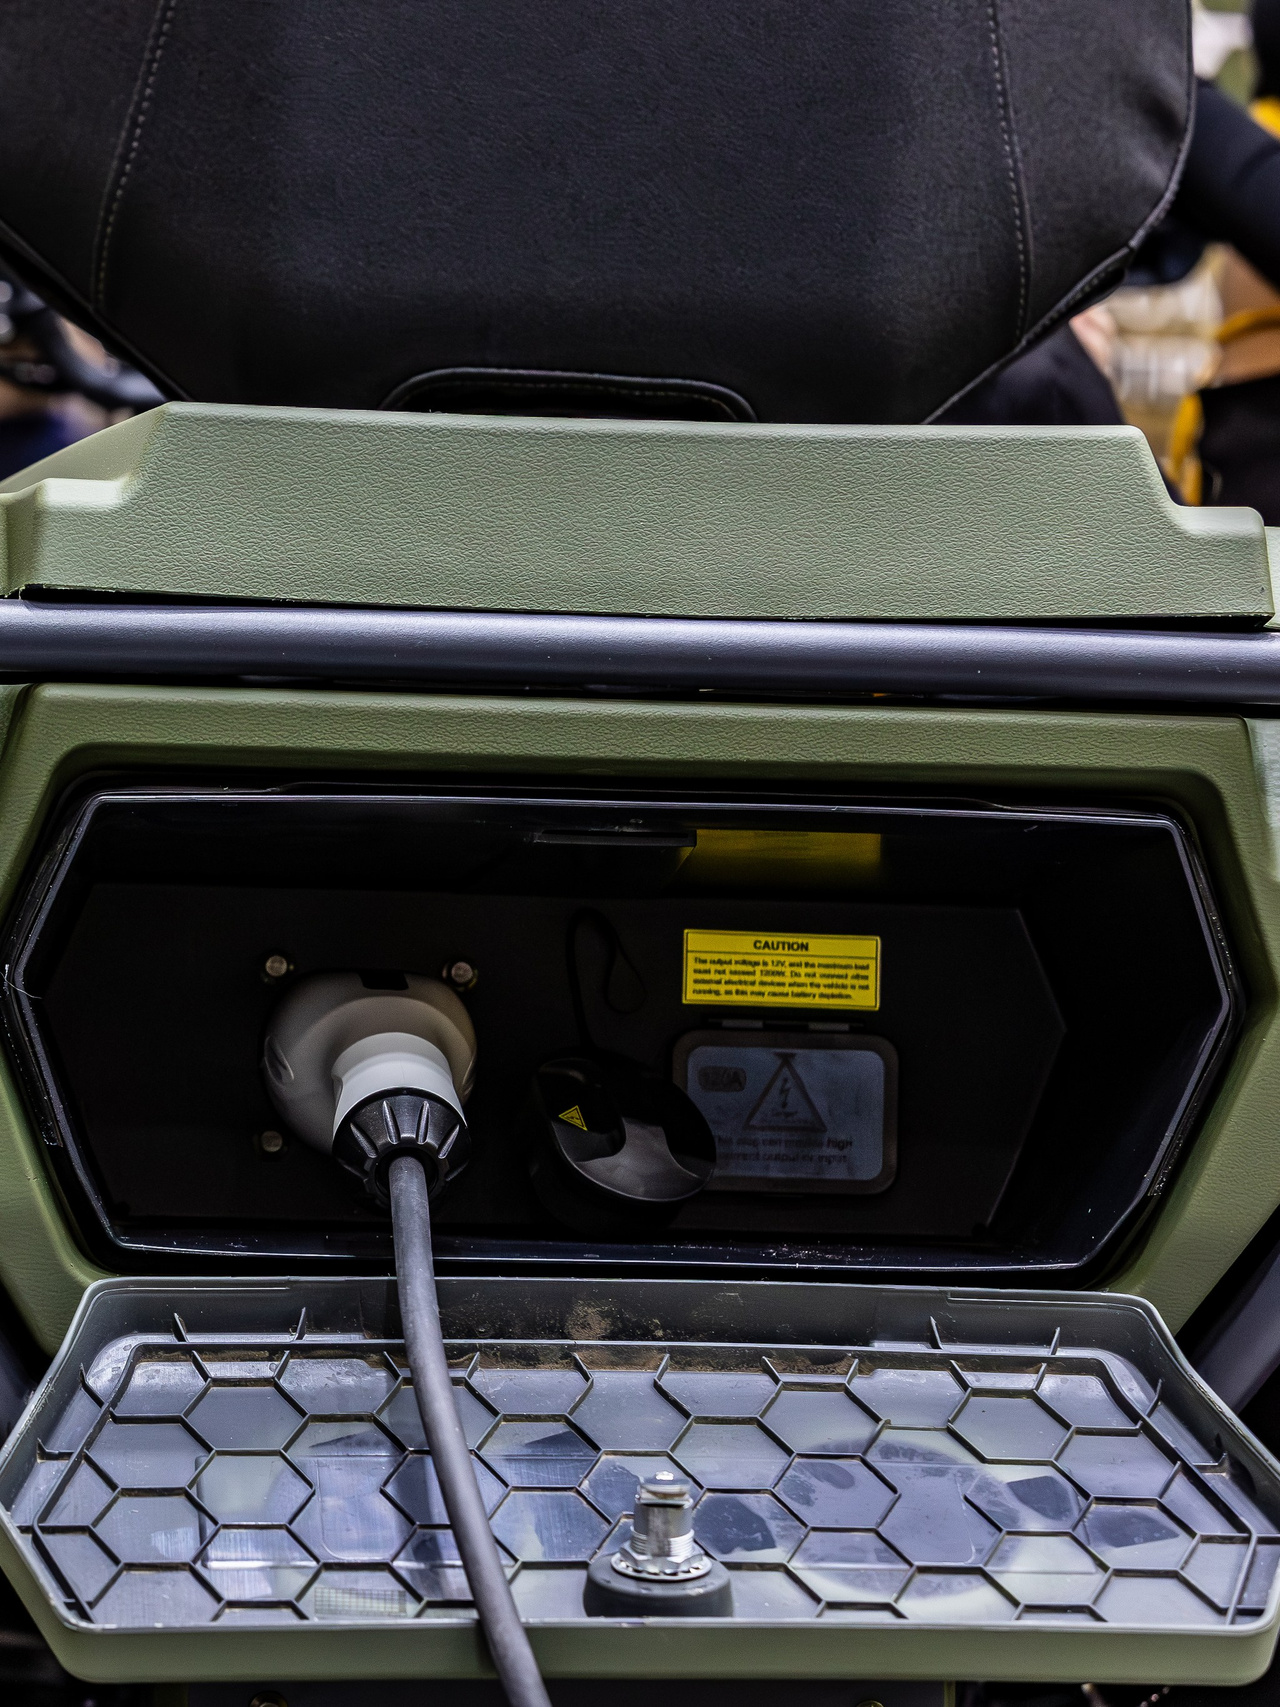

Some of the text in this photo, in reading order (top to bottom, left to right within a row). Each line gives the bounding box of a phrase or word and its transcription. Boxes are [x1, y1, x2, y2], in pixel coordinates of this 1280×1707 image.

[753, 939, 809, 952] CAUTION
[694, 957, 708, 965] The
[709, 958, 732, 966] output
[734, 959, 761, 968] voltage
[804, 961, 816, 969] the
[817, 962, 853, 970] maximum
[790, 970, 801, 978] Do
[750, 990, 766, 998] may
[791, 991, 816, 999] battery
[826, 1137, 853, 1151] high
[763, 1153, 799, 1163] output
[801, 1154, 813, 1162] or
[817, 1154, 847, 1165] input
